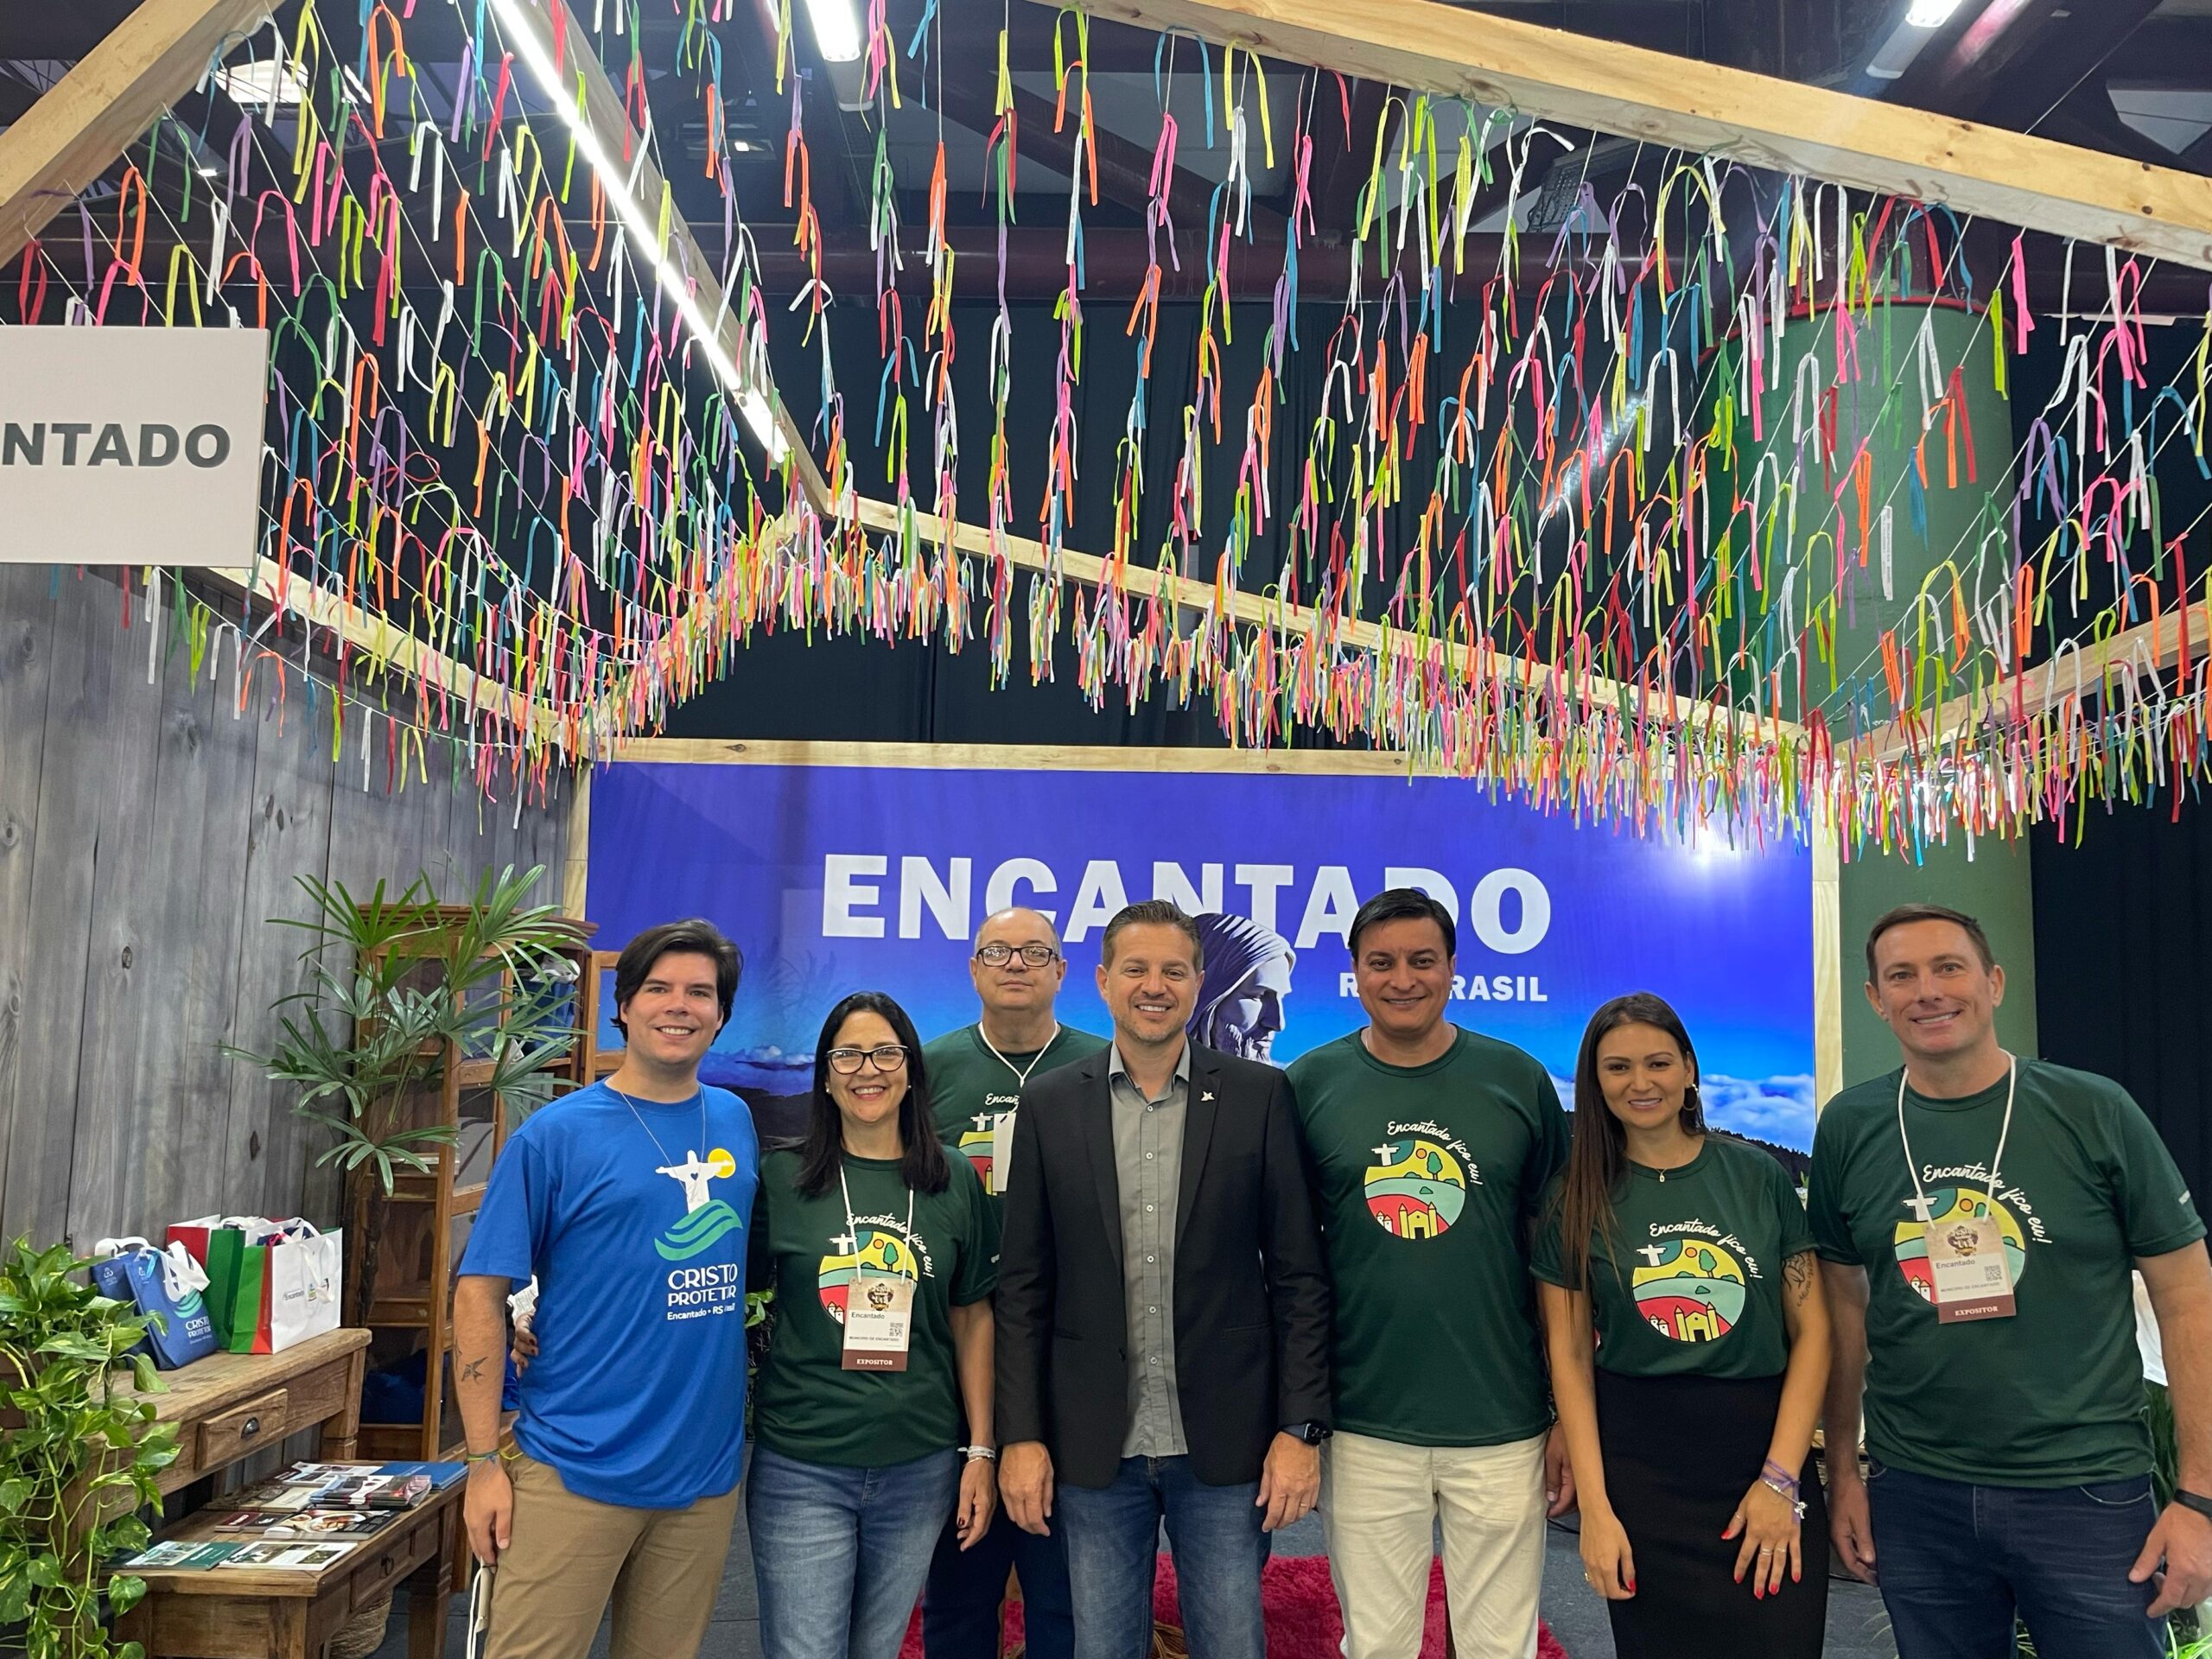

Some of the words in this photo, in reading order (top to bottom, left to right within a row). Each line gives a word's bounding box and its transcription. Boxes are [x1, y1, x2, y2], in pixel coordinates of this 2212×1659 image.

[2, 423, 231, 467] NTADO
[1448, 976, 1548, 1002] RASIL
[985, 1093, 1020, 1105] Encan
[1387, 1120, 1452, 1141] Encantado
[1923, 1162, 2005, 1188] Encantado
[846, 1212, 908, 1233] Encantado
[1649, 1218, 1721, 1236] Encantado
[1936, 1259, 1975, 1268] Encantado
[668, 1263, 738, 1290] CRISTO
[668, 1285, 737, 1307] PROTETR
[667, 1308, 707, 1321] Encantado
[712, 1305, 723, 1314] RS
[1955, 1306, 1999, 1316] EXPOSITOR
